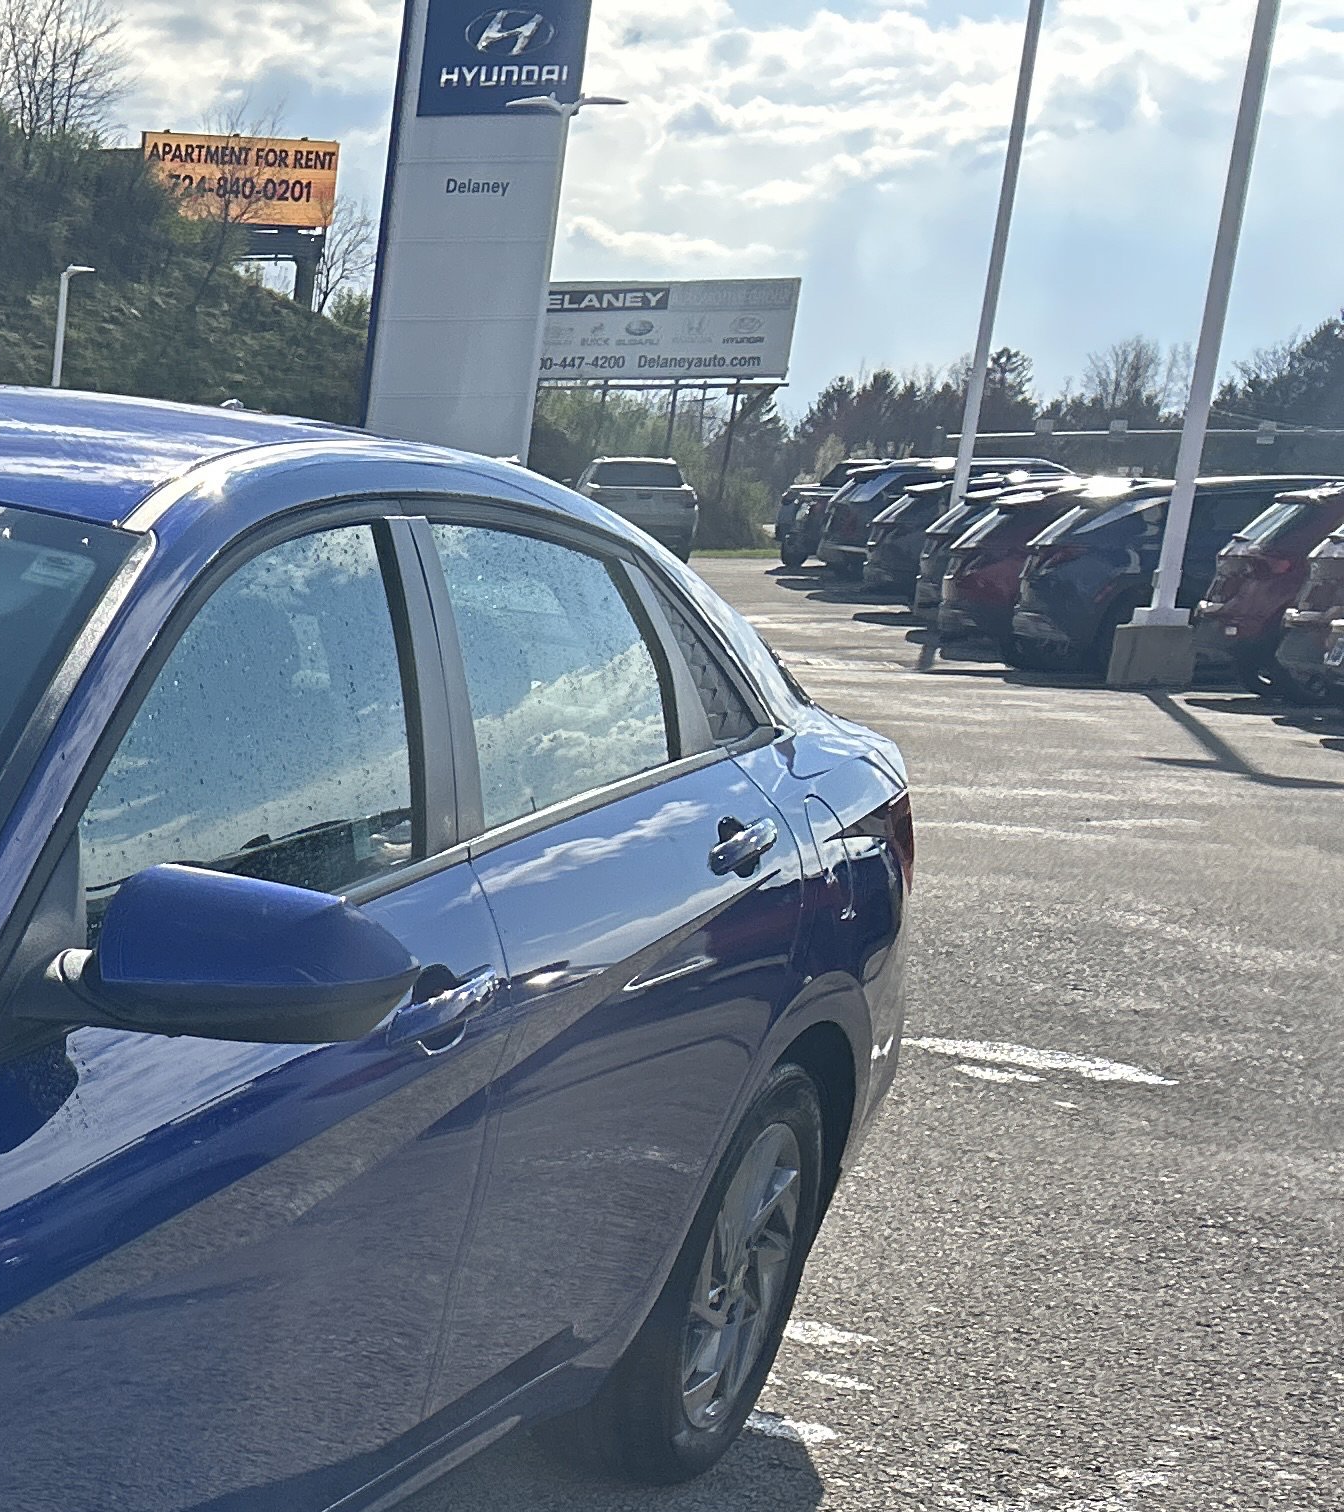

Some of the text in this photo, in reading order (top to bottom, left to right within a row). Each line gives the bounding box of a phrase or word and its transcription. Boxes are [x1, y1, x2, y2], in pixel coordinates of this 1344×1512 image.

[440, 64, 569, 88] HYUNDAI
[148, 141, 336, 172] APARTMENT FOR RENT
[168, 173, 313, 203] 724-840-0201
[445, 178, 511, 197] Delaney
[548, 290, 666, 310] ELANEY
[637, 354, 762, 371] Delaneyauto.com
